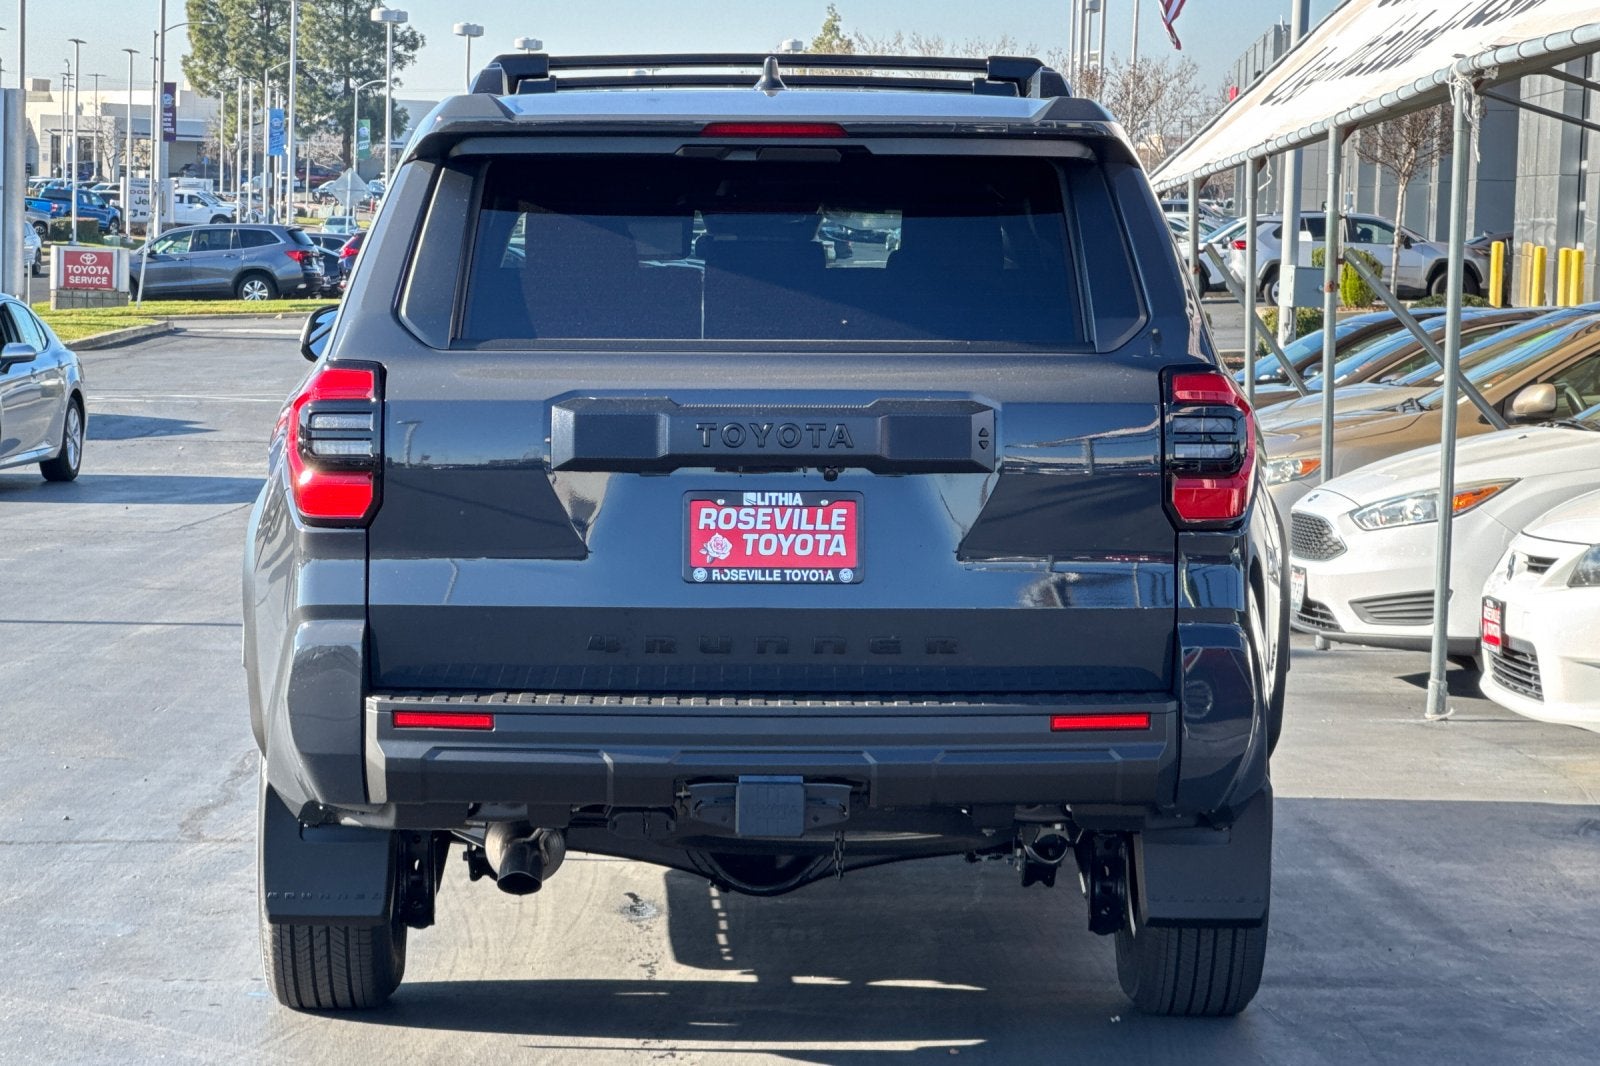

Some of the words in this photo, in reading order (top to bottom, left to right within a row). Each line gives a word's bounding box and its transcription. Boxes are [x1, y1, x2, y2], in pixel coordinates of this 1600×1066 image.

[66, 265, 110, 275] TOYOTA
[68, 275, 108, 285] SERVICE
[696, 422, 854, 448] TOYOTA
[756, 493, 803, 506] LITHIA
[698, 508, 847, 530] ROSEVILLE
[742, 534, 847, 556] TOYOTA
[712, 569, 781, 581] ROSEVILLE
[784, 569, 834, 581] TOYOTA
